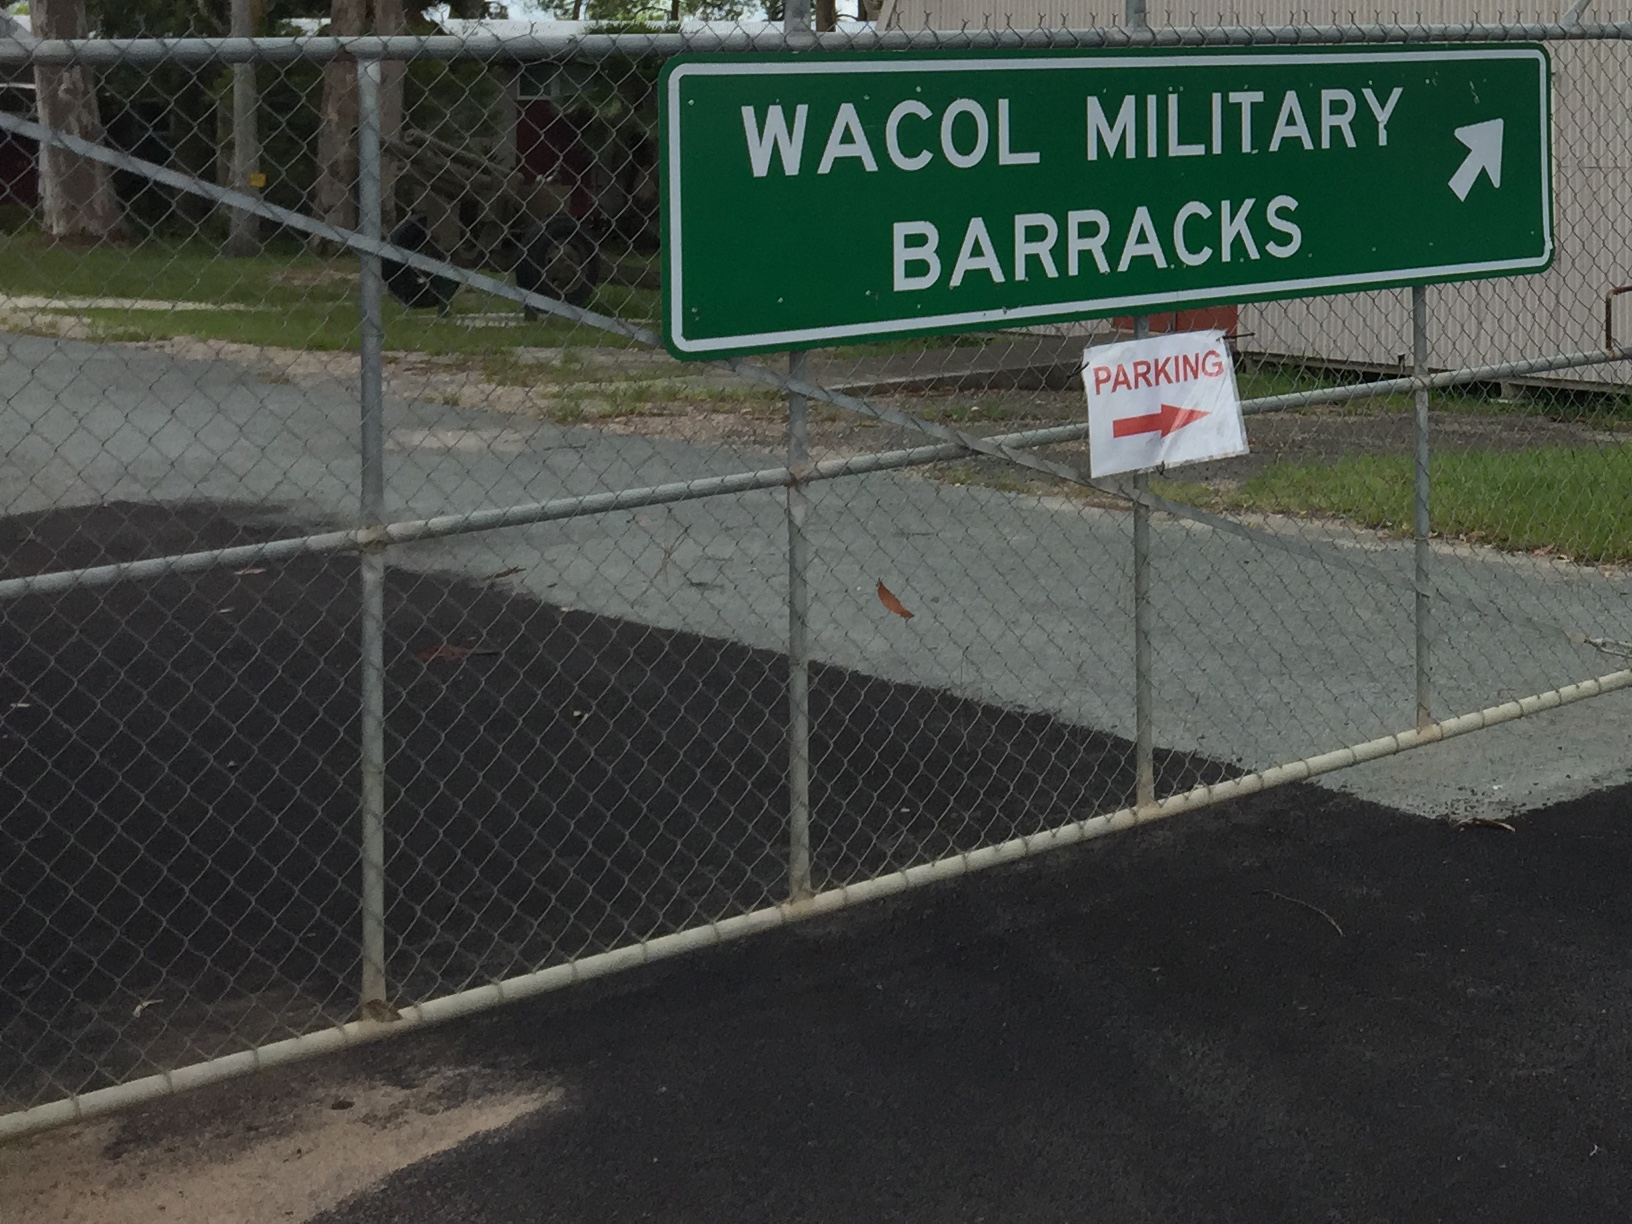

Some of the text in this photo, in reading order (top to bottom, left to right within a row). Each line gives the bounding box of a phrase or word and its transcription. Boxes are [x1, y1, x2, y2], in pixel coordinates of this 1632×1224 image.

[741, 87, 1404, 178] WACOL MILITARY
[892, 194, 1303, 293] BARRACKS
[1093, 349, 1224, 395] PARKING
